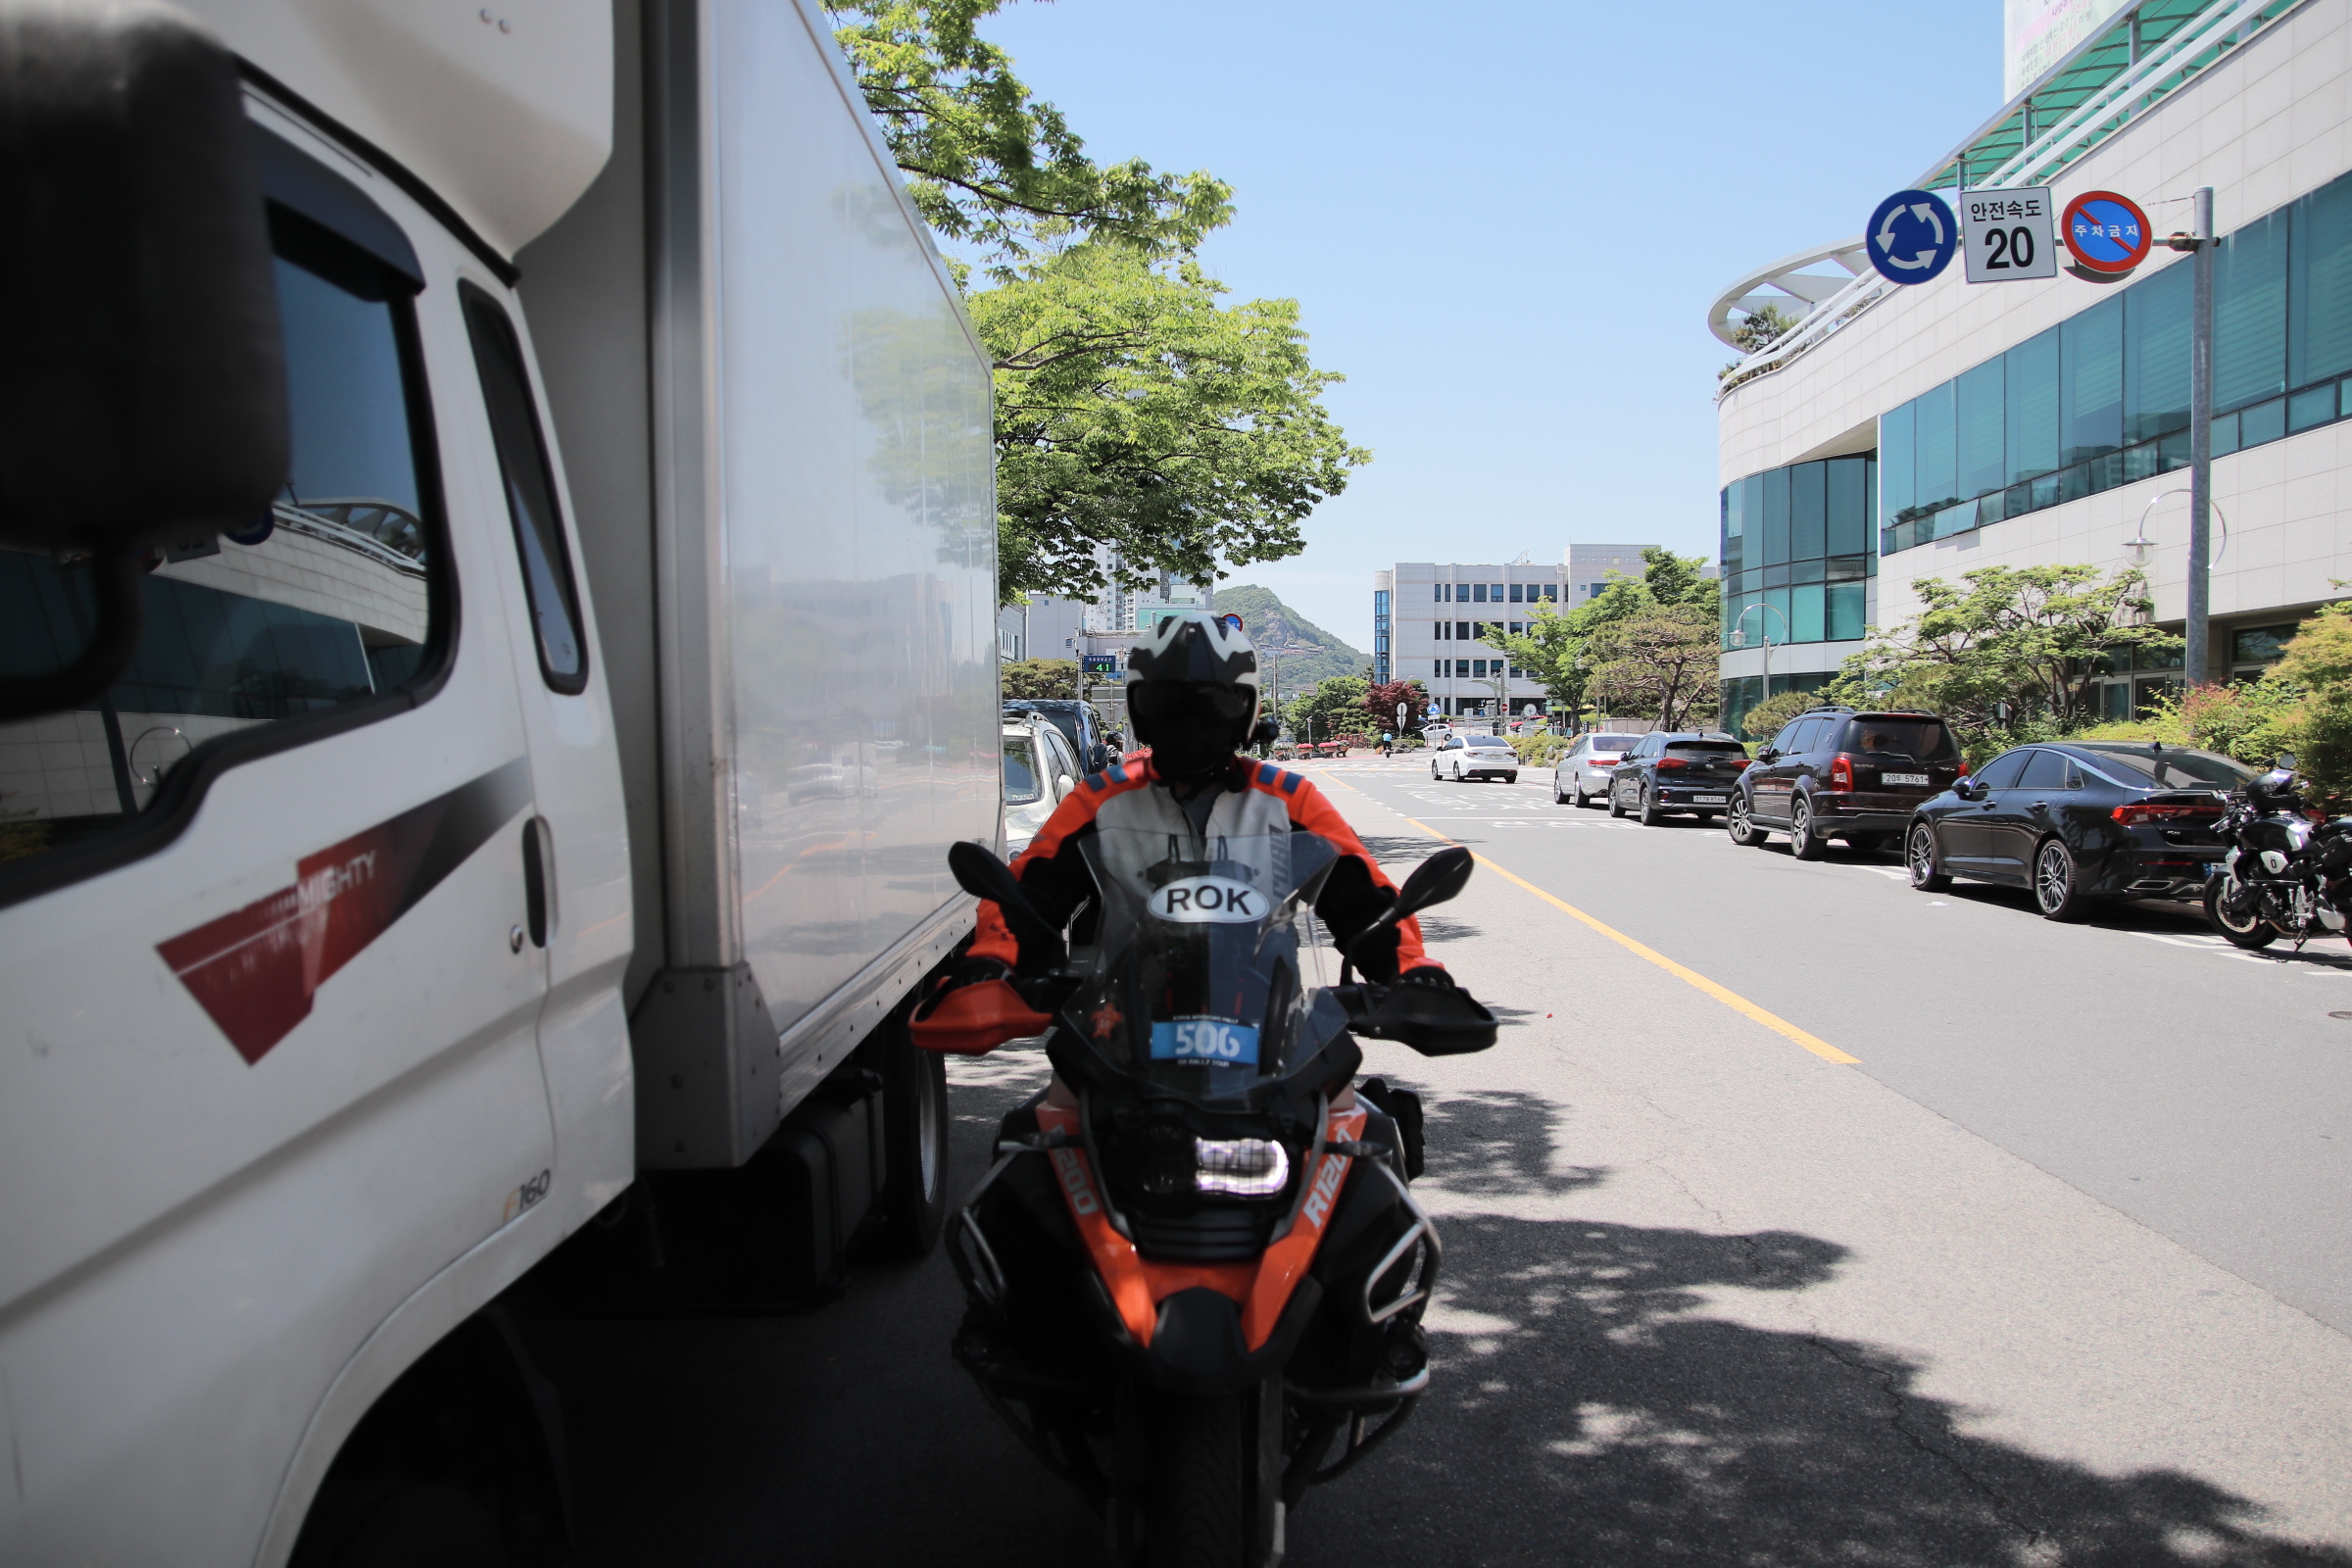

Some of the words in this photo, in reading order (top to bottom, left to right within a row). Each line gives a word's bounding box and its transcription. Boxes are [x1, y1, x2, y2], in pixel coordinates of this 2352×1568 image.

[1971, 199, 2042, 222] 안전속도
[2074, 224, 2138, 237] 주차금지
[1984, 225, 2034, 270] 20
[297, 850, 377, 906] MIGHTY
[1166, 885, 1251, 915] ROK
[1175, 1023, 1241, 1057] 506
